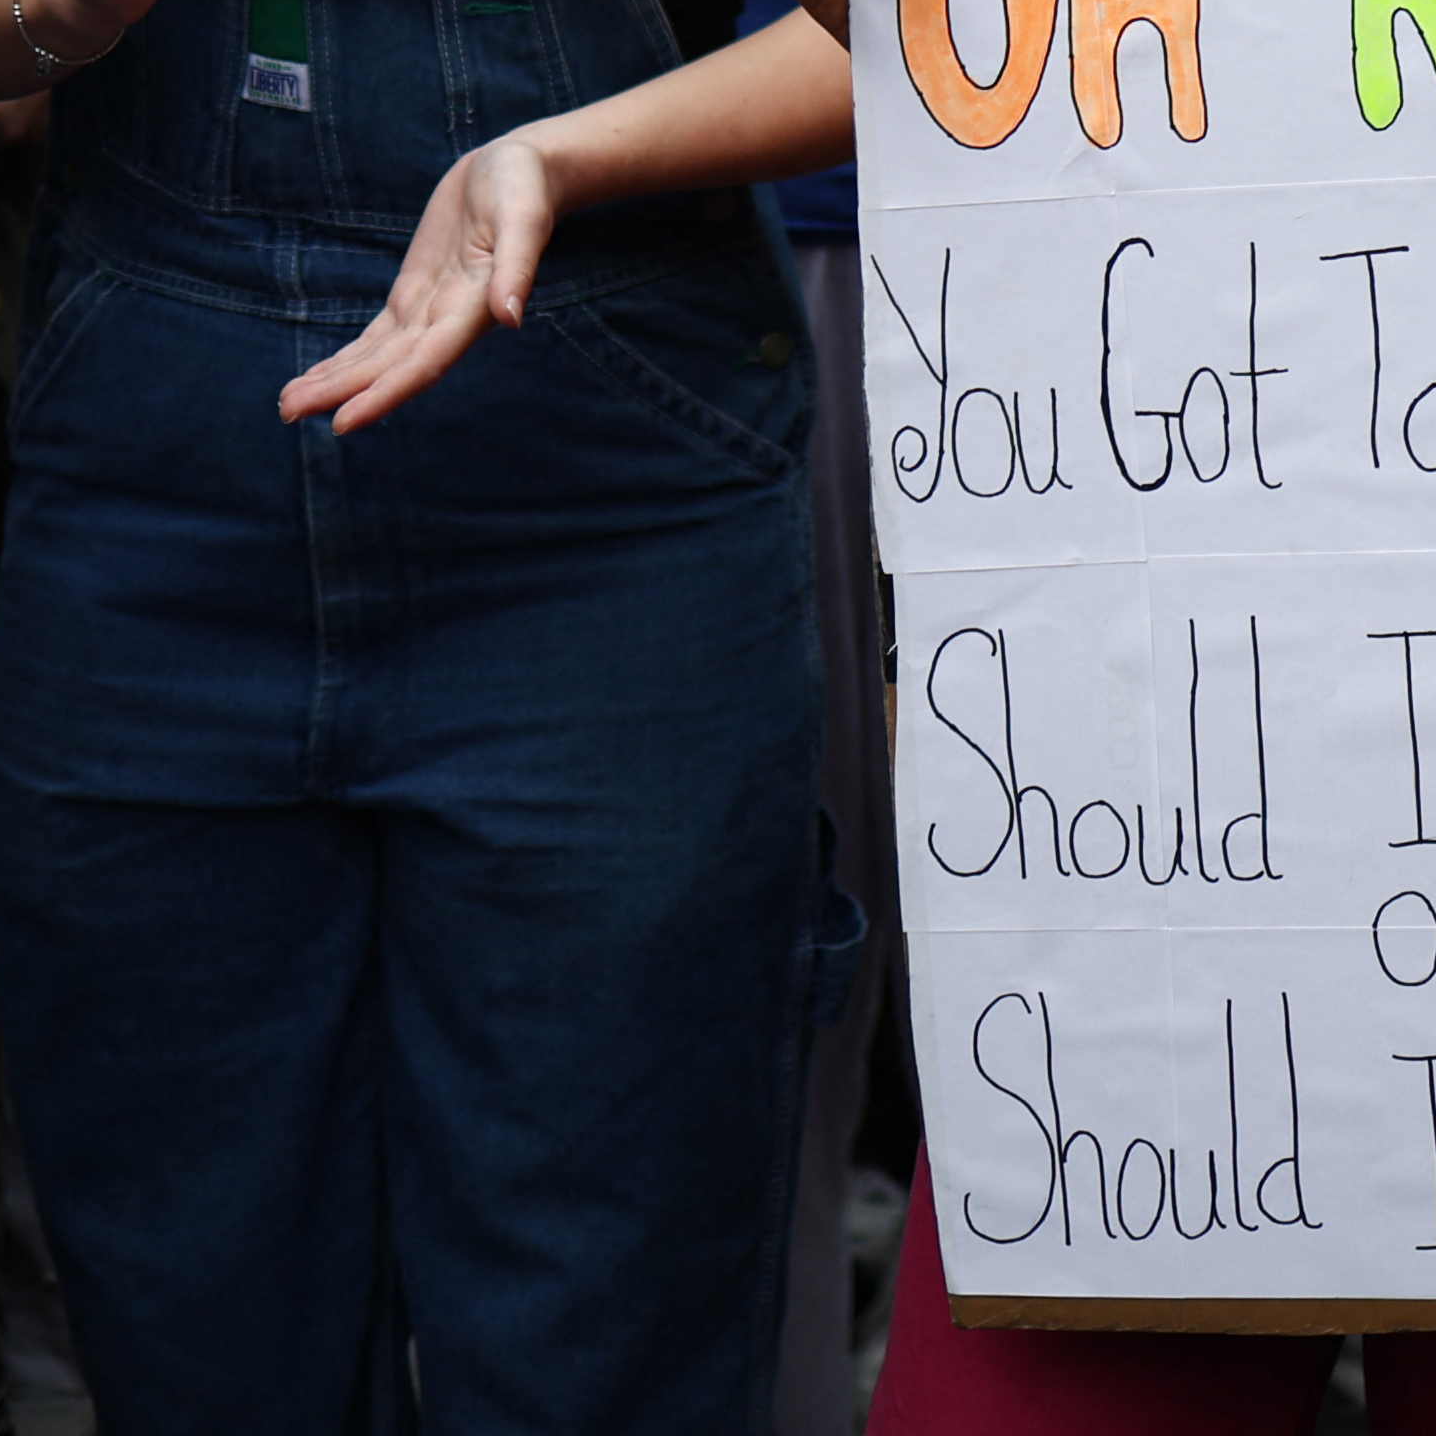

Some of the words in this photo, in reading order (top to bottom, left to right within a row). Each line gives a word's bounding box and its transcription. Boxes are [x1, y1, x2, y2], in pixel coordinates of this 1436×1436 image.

[871, 248, 1073, 503] You
[1101, 238, 1288, 491] Got
[927, 616, 1283, 885] Should
[964, 992, 1323, 1246] Should
